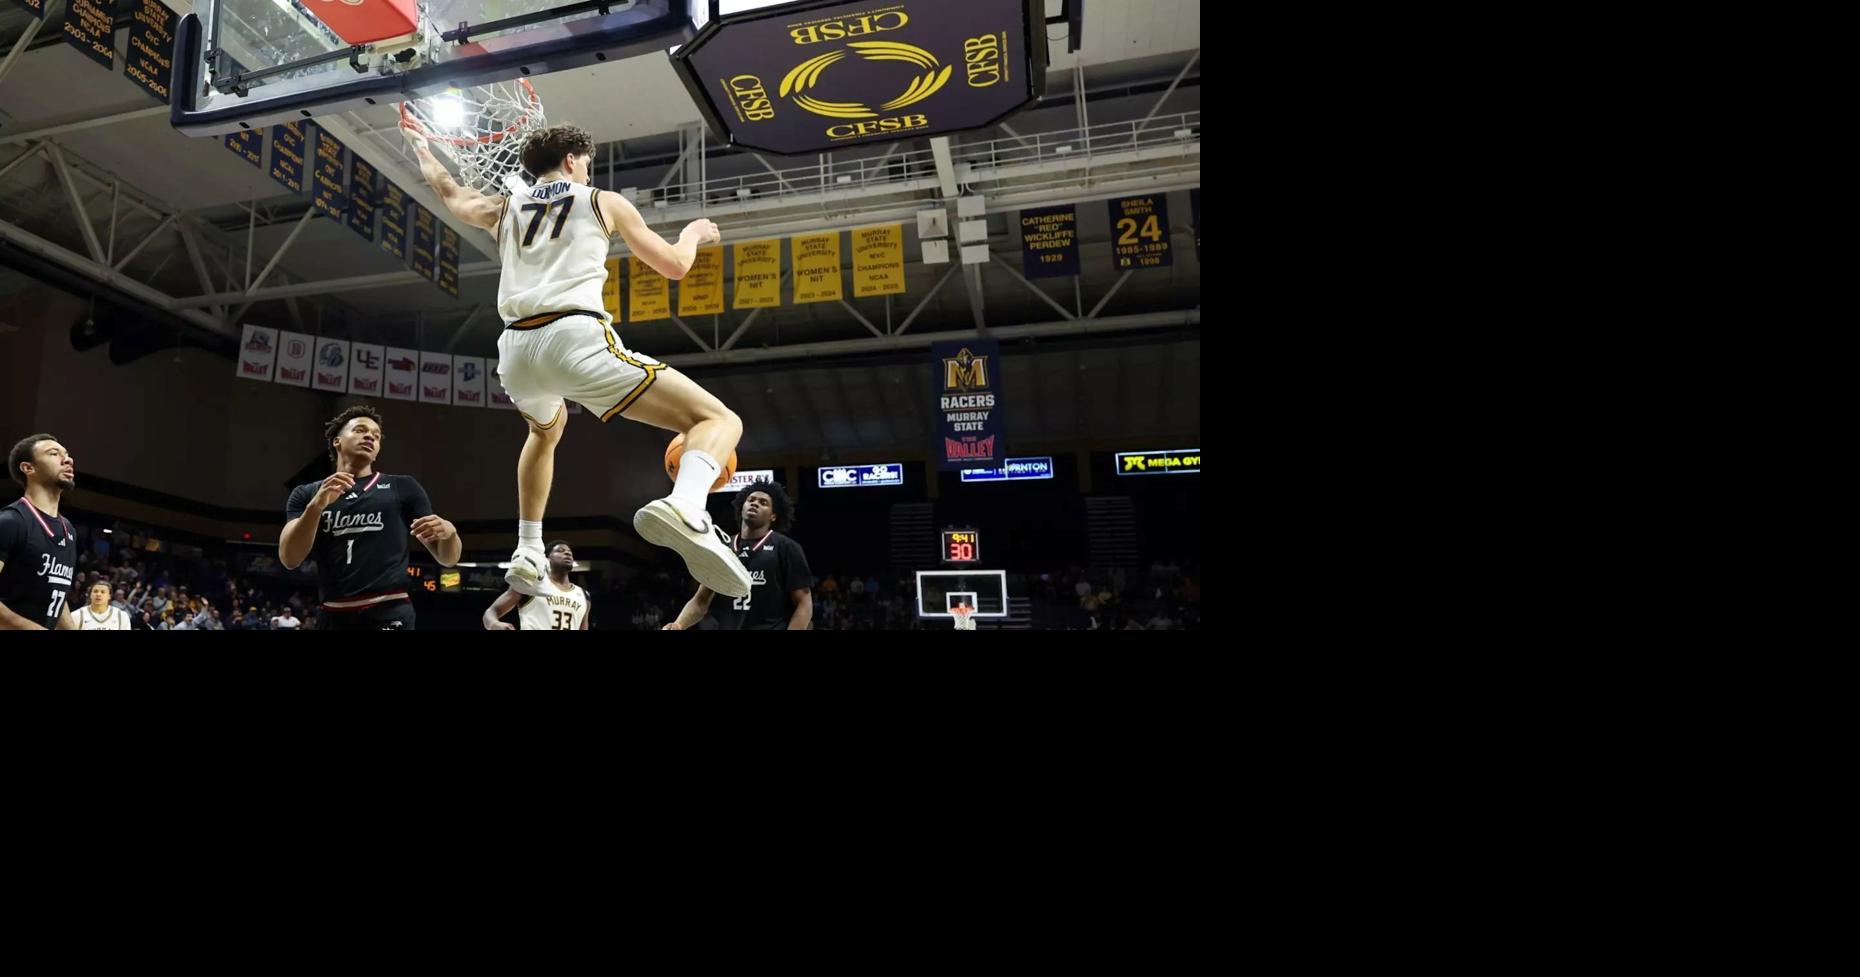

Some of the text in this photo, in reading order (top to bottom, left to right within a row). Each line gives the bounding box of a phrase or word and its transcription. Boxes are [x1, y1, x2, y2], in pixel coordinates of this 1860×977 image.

[790, 11, 909, 45] CFSB
[964, 33, 999, 88] CFSB
[730, 74, 776, 121] CFSB
[825, 113, 929, 139] CFSB
[532, 182, 571, 199] DOMON
[1120, 198, 1153, 208] SHEILA
[1123, 206, 1152, 215] SMITH
[520, 195, 575, 247] 77
[1022, 213, 1074, 226] CATHERINE
[861, 229, 891, 238] MURRAY
[1116, 214, 1163, 245] 24
[801, 237, 829, 247] MURRAY
[1024, 230, 1074, 243] WICKLIFFE
[856, 243, 898, 254] UNIVERSITY
[1029, 239, 1071, 250] PERDEW
[797, 251, 836, 260] UNIVERSITY
[1040, 254, 1063, 263] 1929
[797, 266, 837, 277] WOMEN'S
[857, 262, 900, 272] CHAMPIONS
[737, 272, 776, 281] WOMEN'S
[810, 275, 824, 283] NIT
[940, 394, 995, 409] RACERS
[946, 411, 989, 423] MURRAY
[954, 421, 984, 432] STATE
[945, 434, 995, 459] VALLEY
[1148, 458, 1181, 467] MEGA
[322, 511, 382, 534] Flames
[952, 533, 974, 543] 9:41
[345, 540, 354, 564] 1
[950, 543, 972, 560] 30
[423, 580, 437, 591] 45
[46, 589, 66, 618] 27
[546, 594, 582, 612] MURRAY
[552, 610, 572, 631] 33
